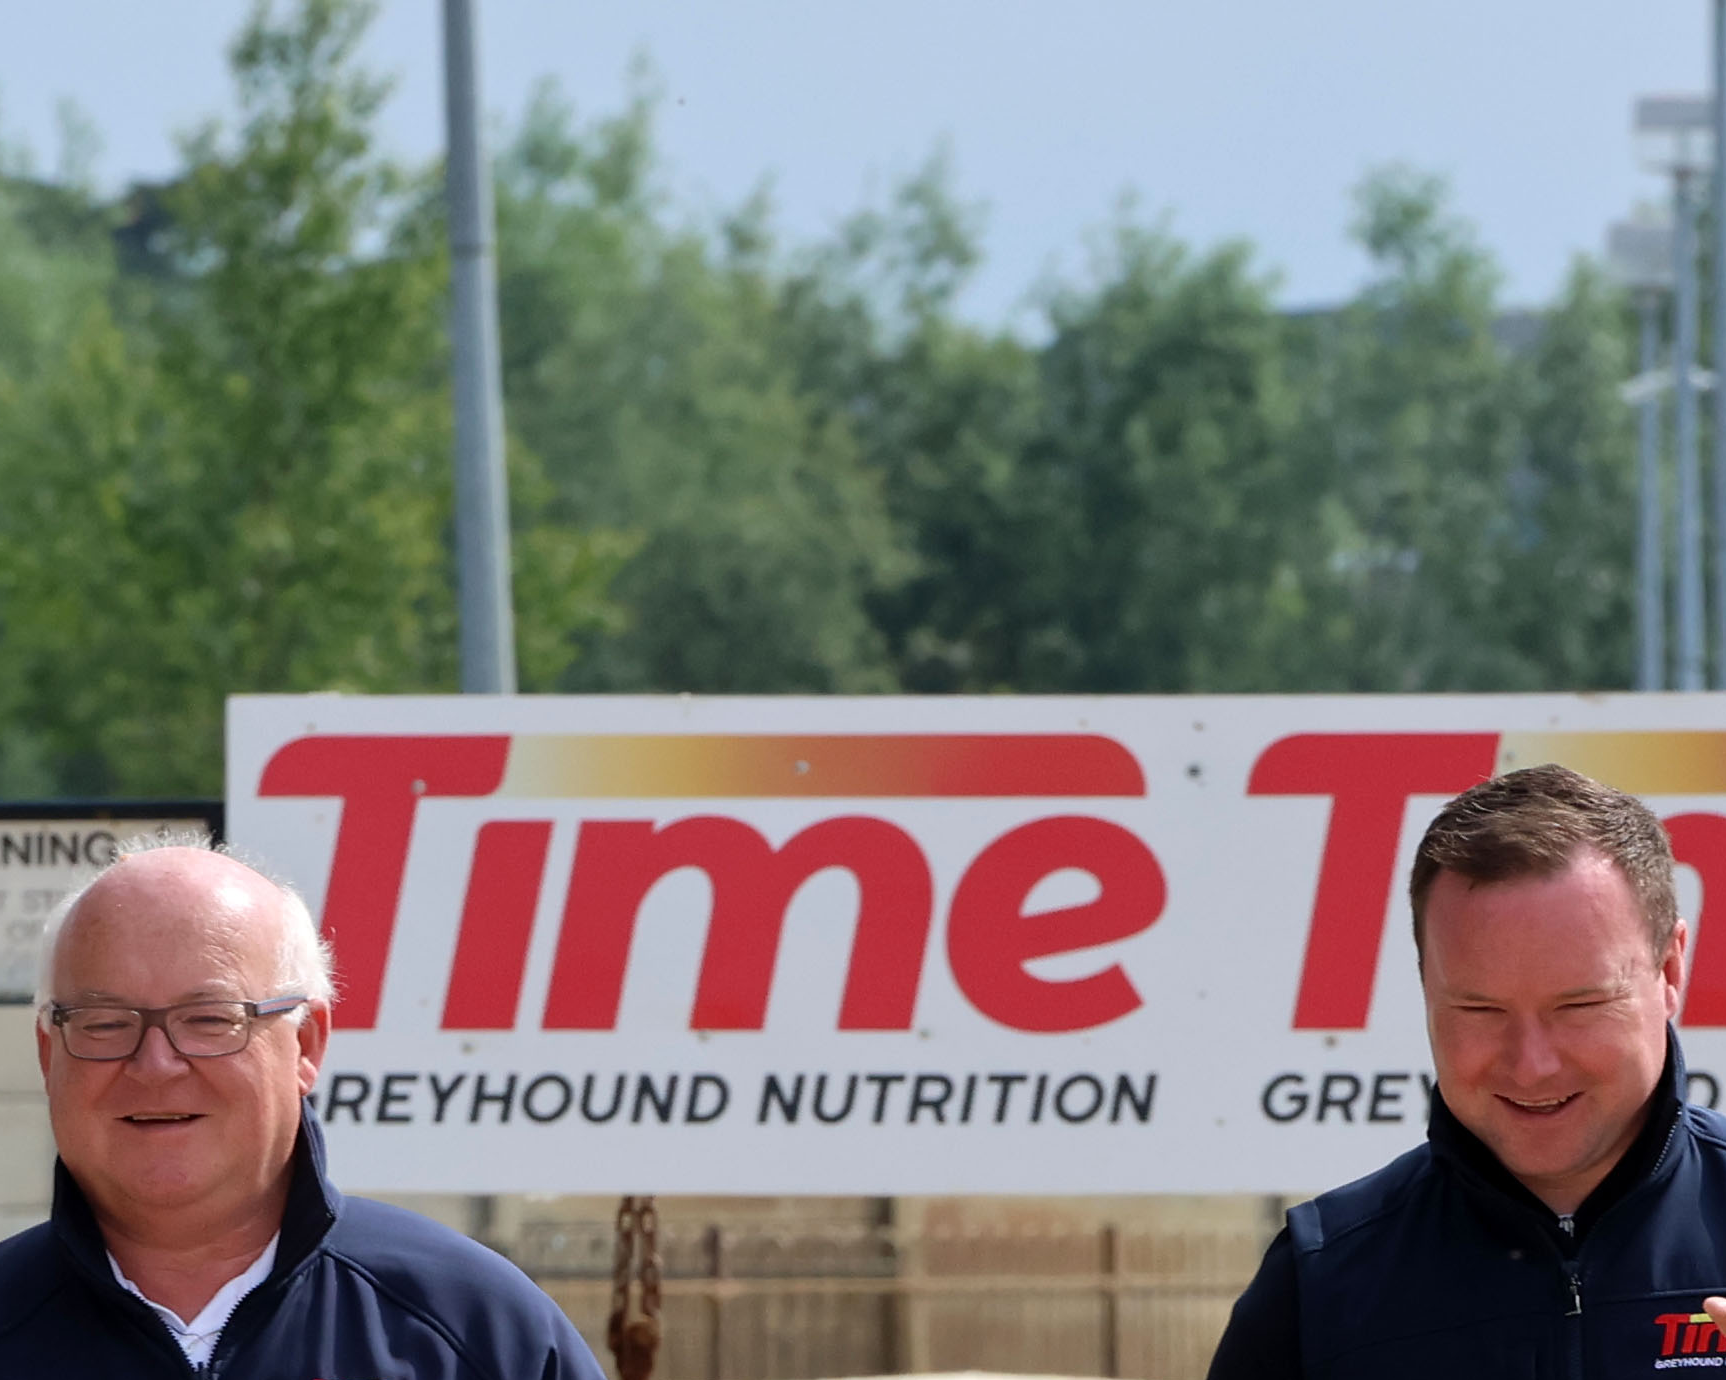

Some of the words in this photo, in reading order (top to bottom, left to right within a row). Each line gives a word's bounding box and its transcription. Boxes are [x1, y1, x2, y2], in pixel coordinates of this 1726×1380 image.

[256, 733, 1169, 1033] Time
[309, 1072, 731, 1125] REYHOUND
[757, 1072, 1159, 1126] NUTRITION
[1655, 1357, 1723, 1369] GREYHOUND
